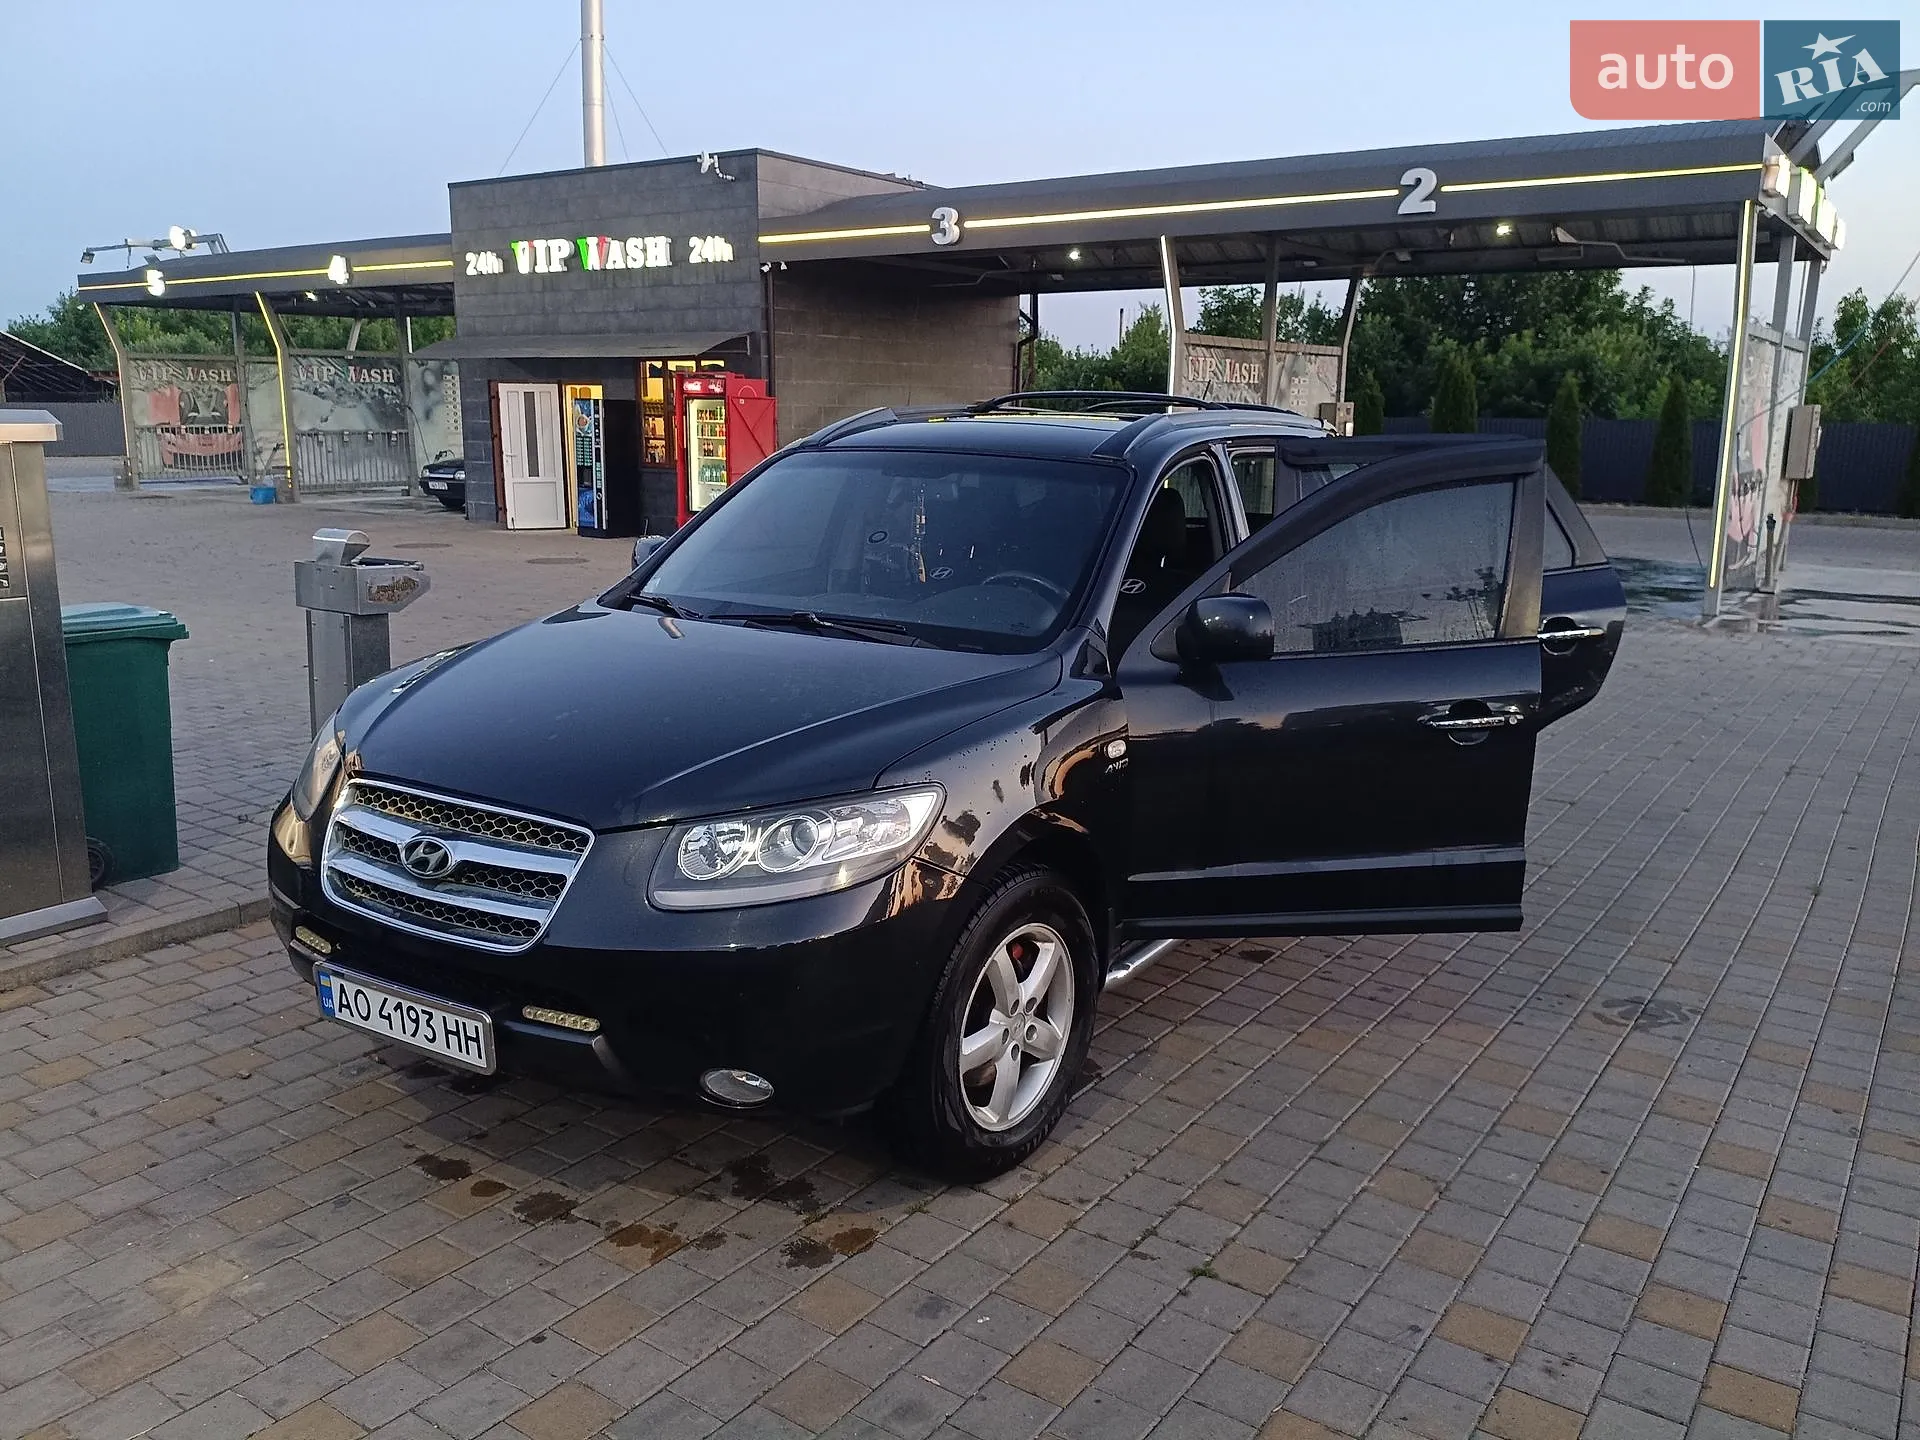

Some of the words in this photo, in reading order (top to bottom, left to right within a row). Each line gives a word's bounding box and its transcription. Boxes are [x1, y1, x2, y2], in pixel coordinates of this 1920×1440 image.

[1397, 168, 1436, 215] 2
[930, 206, 961, 246] 3
[465, 251, 504, 276] 24h
[511, 238, 574, 275] VIP
[576, 235, 673, 272] WASH
[688, 235, 734, 264] 24h
[145, 269, 166, 297] 5
[138, 366, 171, 381] VIP
[184, 366, 233, 382] WASH
[298, 365, 336, 383] VIP
[345, 365, 395, 384] WASH
[1221, 358, 1260, 384] WASH
[322, 997, 334, 1009] UA
[338, 983, 372, 1022] AO
[378, 997, 437, 1044] 4193
[442, 1015, 483, 1060] HH
